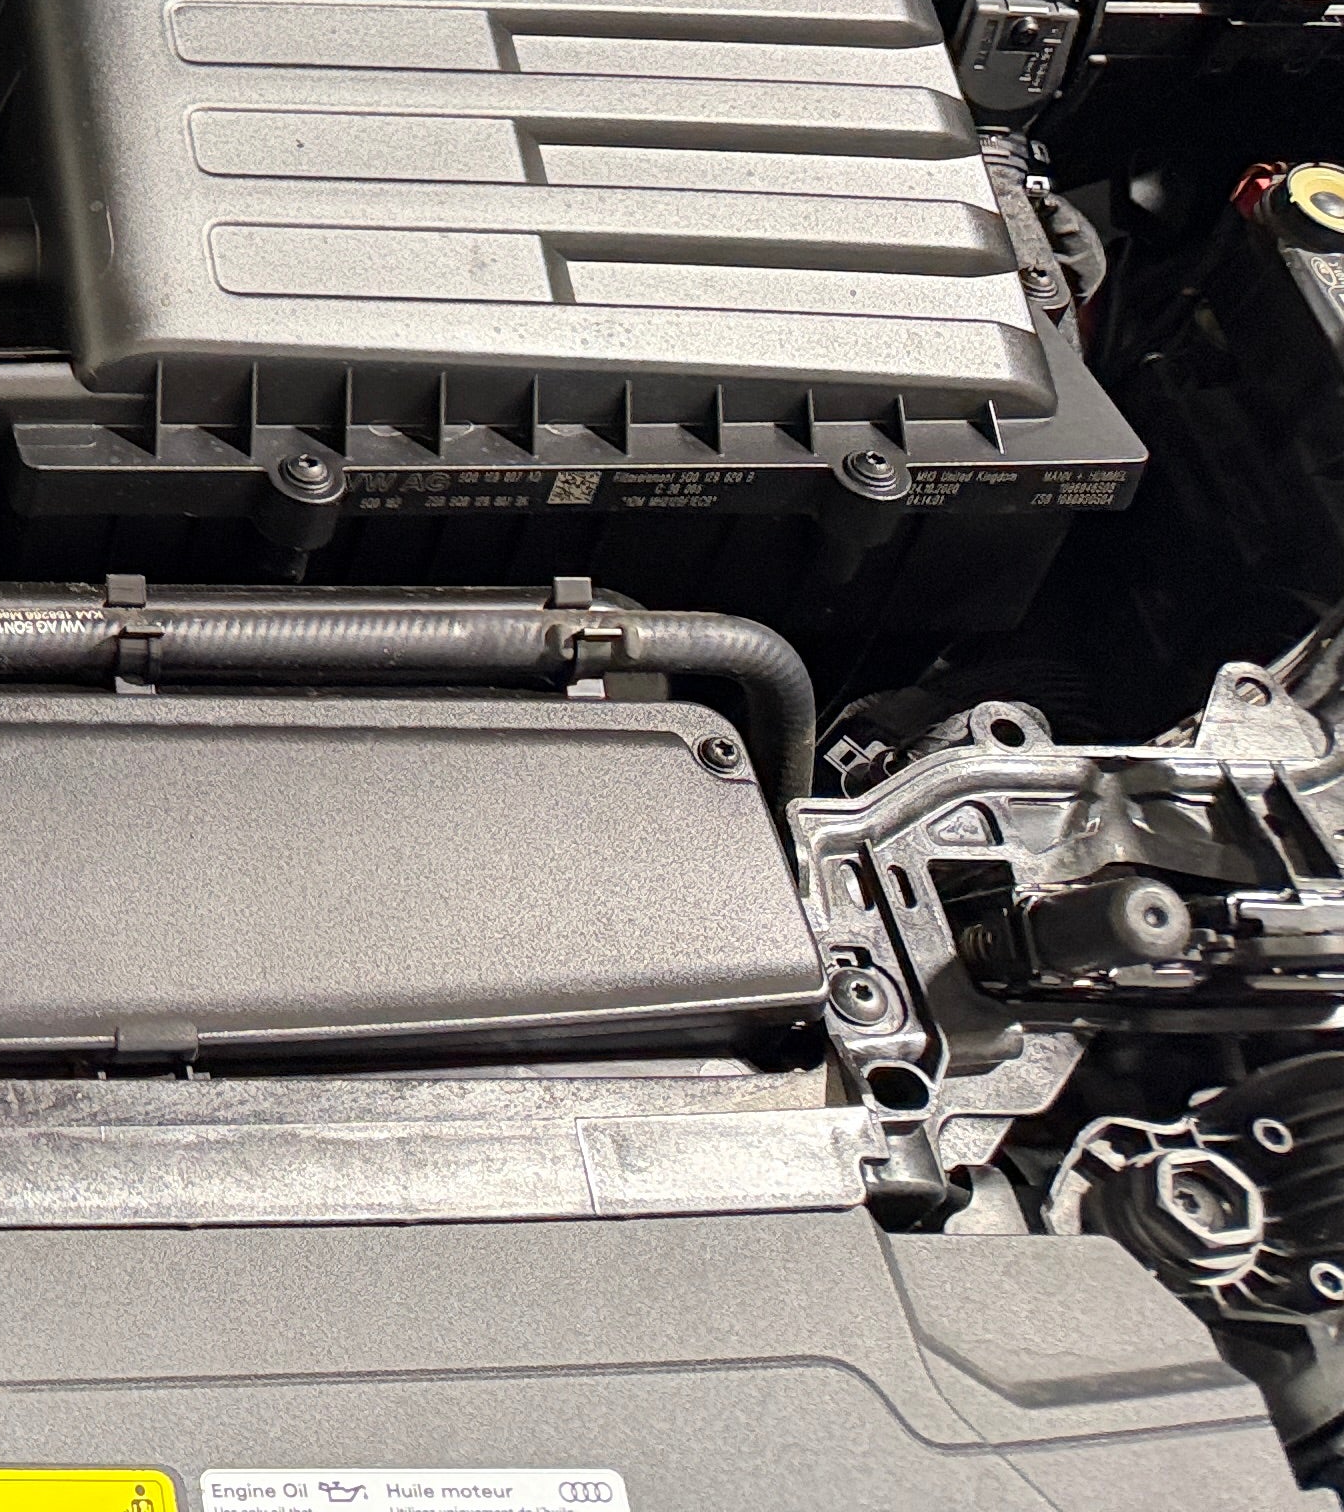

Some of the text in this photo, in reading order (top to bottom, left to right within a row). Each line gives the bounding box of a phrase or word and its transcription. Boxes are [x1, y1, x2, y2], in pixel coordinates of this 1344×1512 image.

[940, 470, 974, 483] United
[976, 470, 1018, 485] Kingdom
[35, 619, 58, 634] AG
[61, 619, 86, 634] VW
[211, 1482, 309, 1502] Engine Oil
[386, 1483, 513, 1499] Huile moteur
